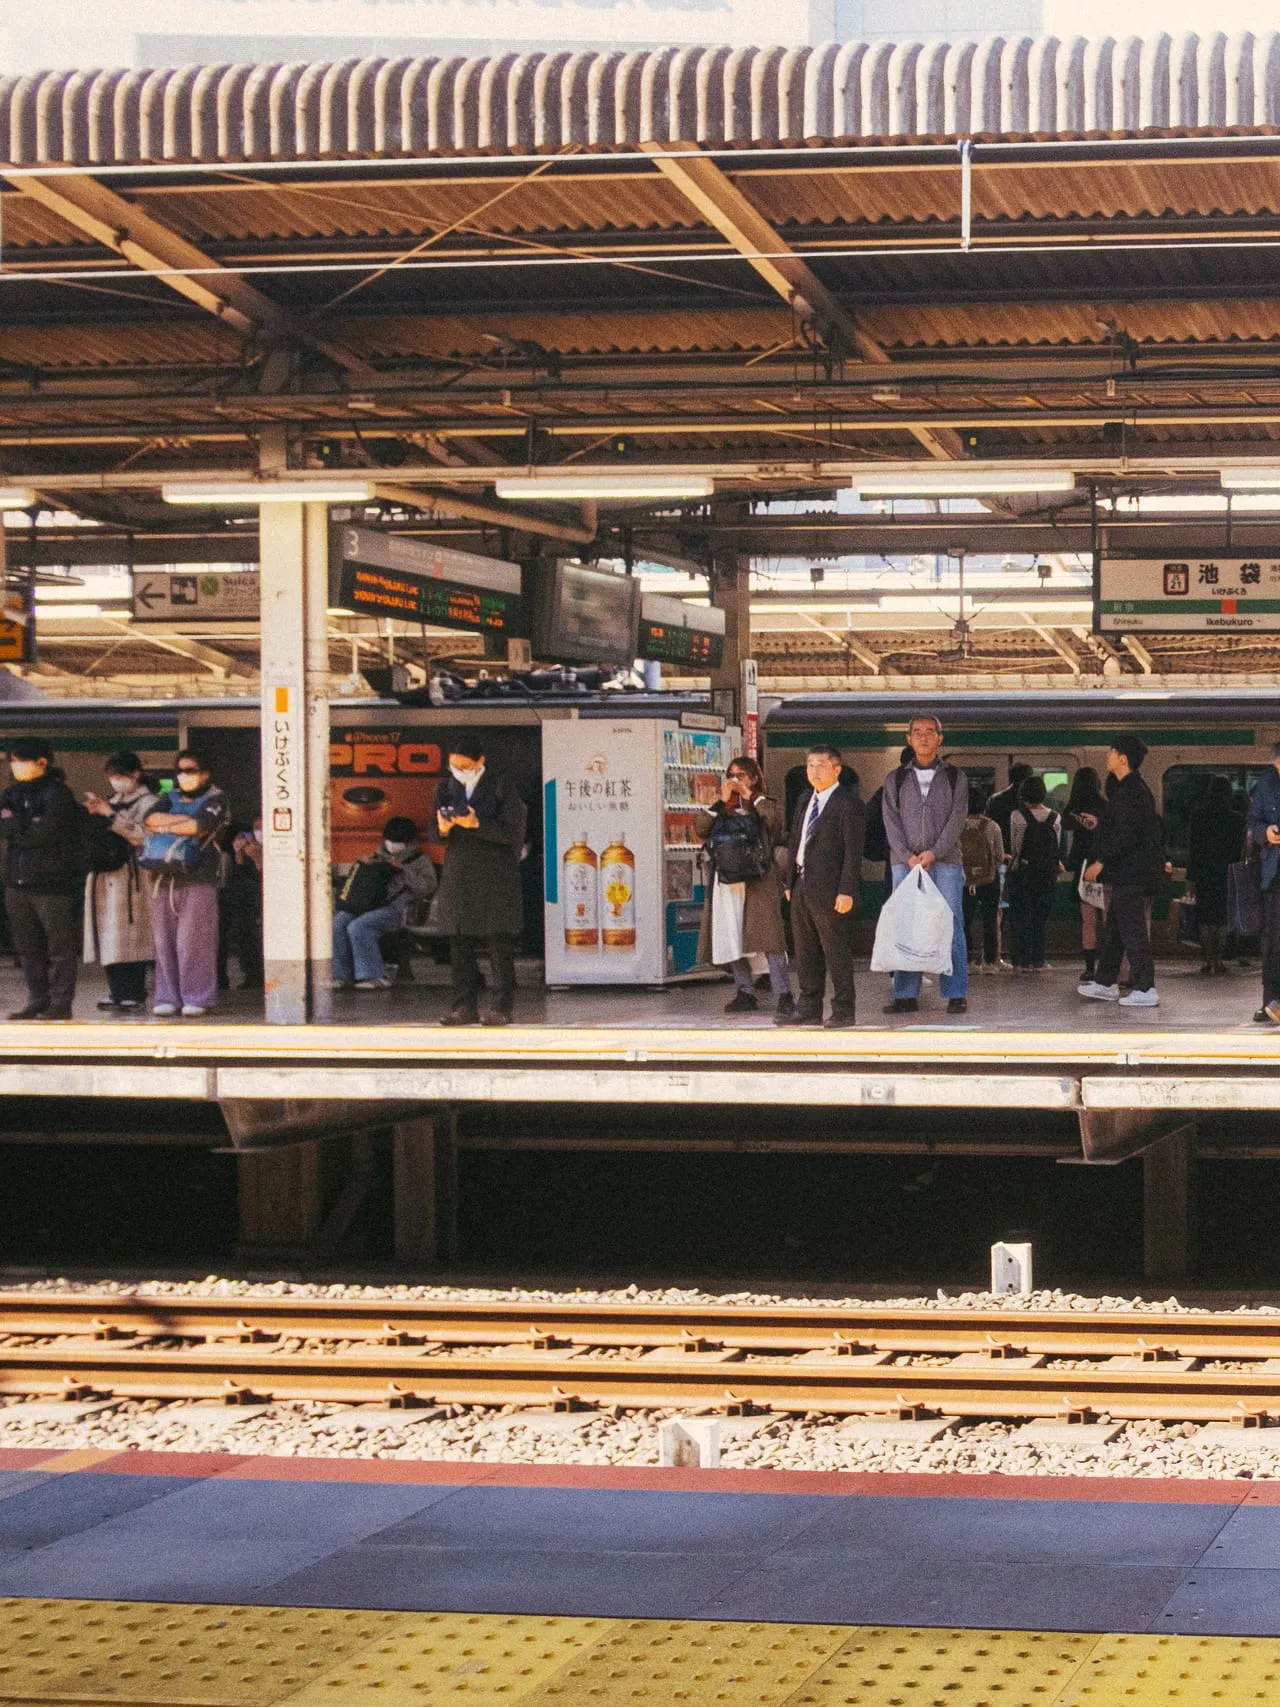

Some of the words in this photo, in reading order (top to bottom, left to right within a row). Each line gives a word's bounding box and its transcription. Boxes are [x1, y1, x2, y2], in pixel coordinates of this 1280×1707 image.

[347, 530, 359, 556] 3
[1198, 563, 1261, 585] 池袋
[1211, 587, 1247, 596] いけぶくろ
[1206, 617, 1254, 626] Ikebukuro
[274, 719, 290, 801] いけぶくろ
